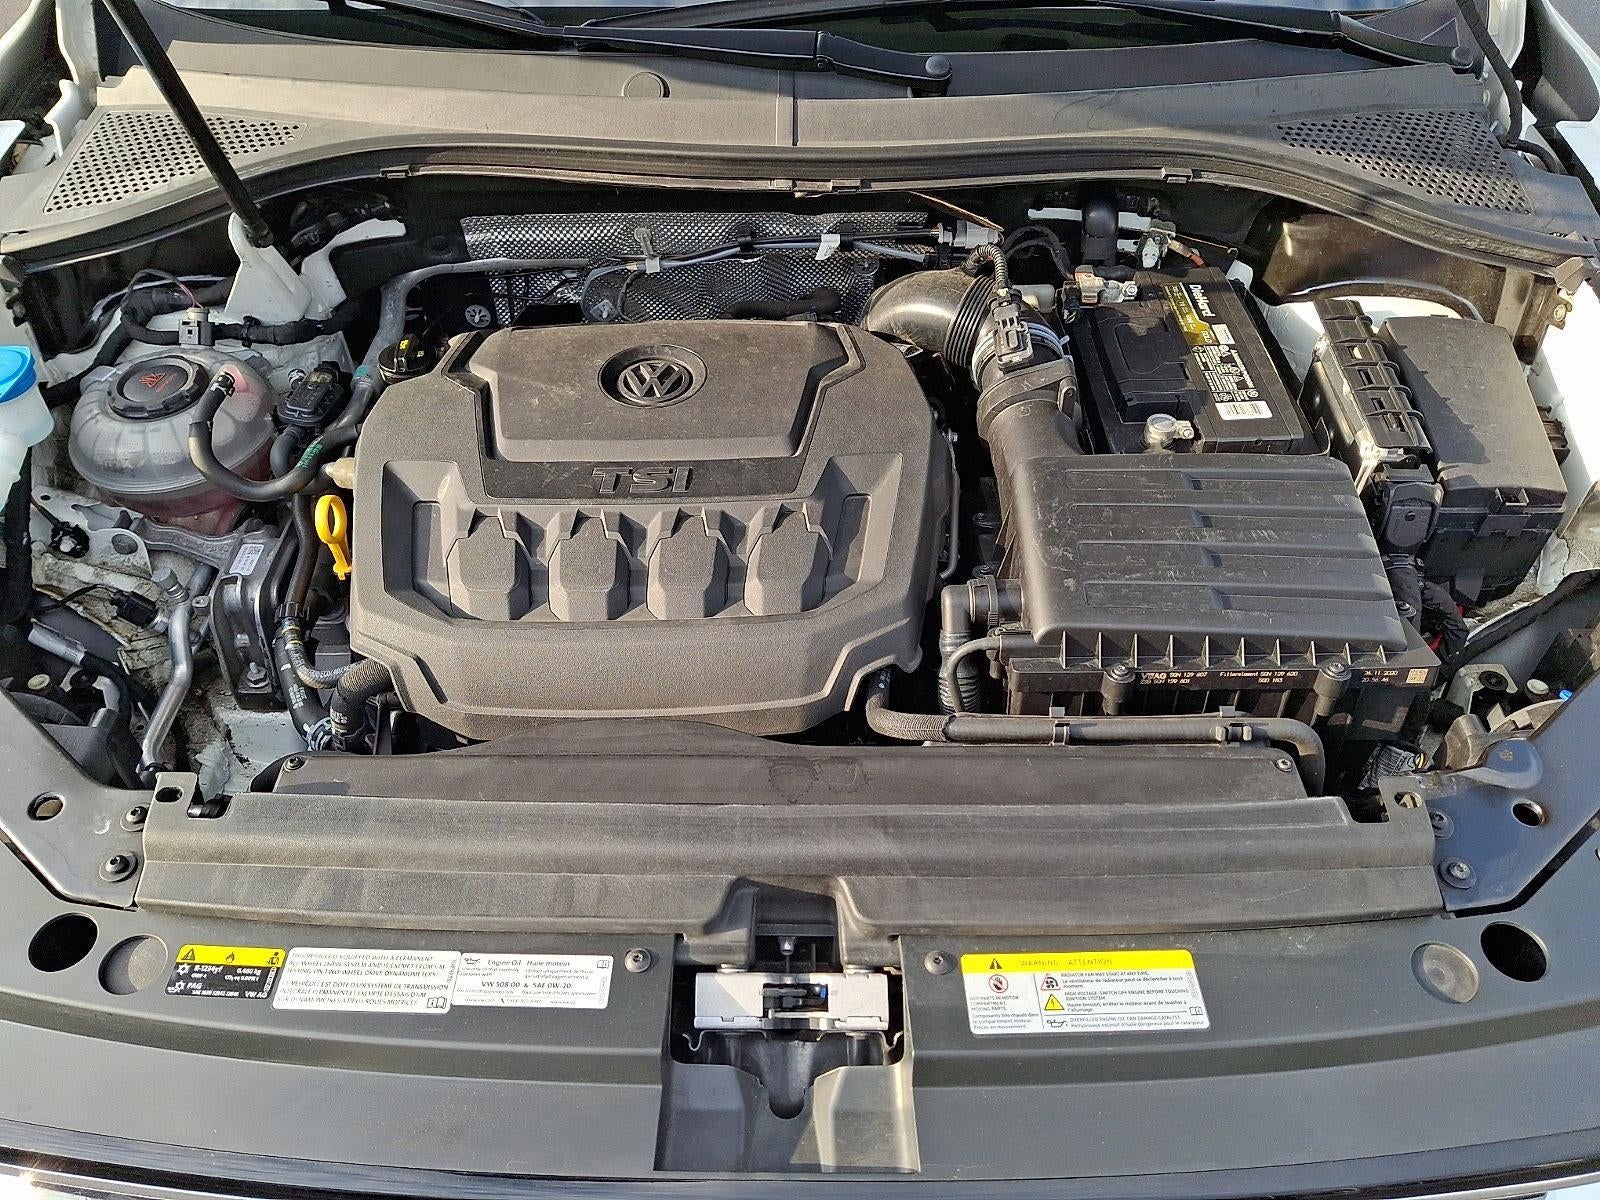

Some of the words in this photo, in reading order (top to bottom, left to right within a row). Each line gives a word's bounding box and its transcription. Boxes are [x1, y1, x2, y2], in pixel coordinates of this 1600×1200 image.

[1189, 284, 1216, 317] DieHard
[591, 466, 693, 493] TSI
[193, 965, 223, 974] R-1234yf
